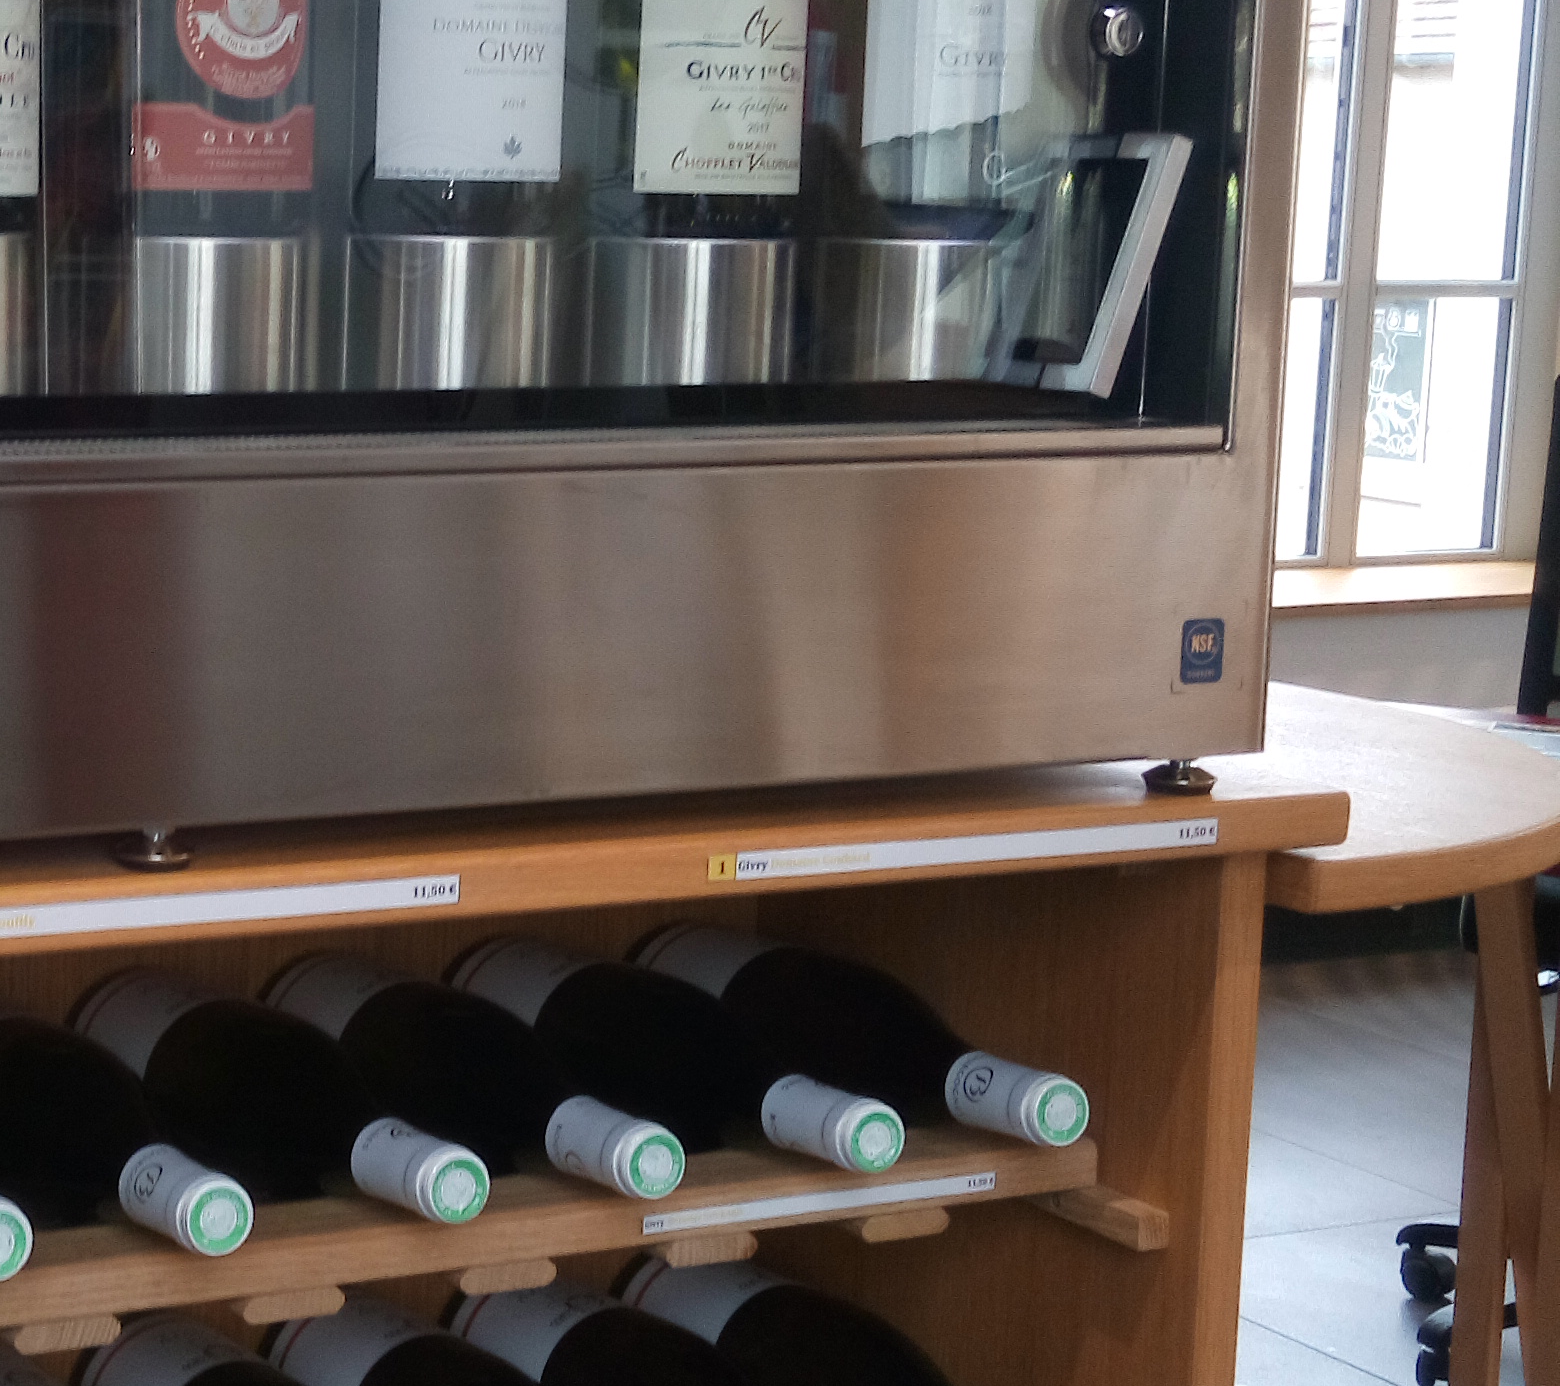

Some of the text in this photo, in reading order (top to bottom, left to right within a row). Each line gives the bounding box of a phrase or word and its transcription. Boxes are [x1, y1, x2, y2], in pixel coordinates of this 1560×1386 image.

[3, 31, 36, 61] Cru
[478, 38, 545, 63] GIVRY
[686, 60, 756, 81] GIVRY
[202, 129, 290, 146] GIVRY
[1191, 633, 1215, 654] NSF
